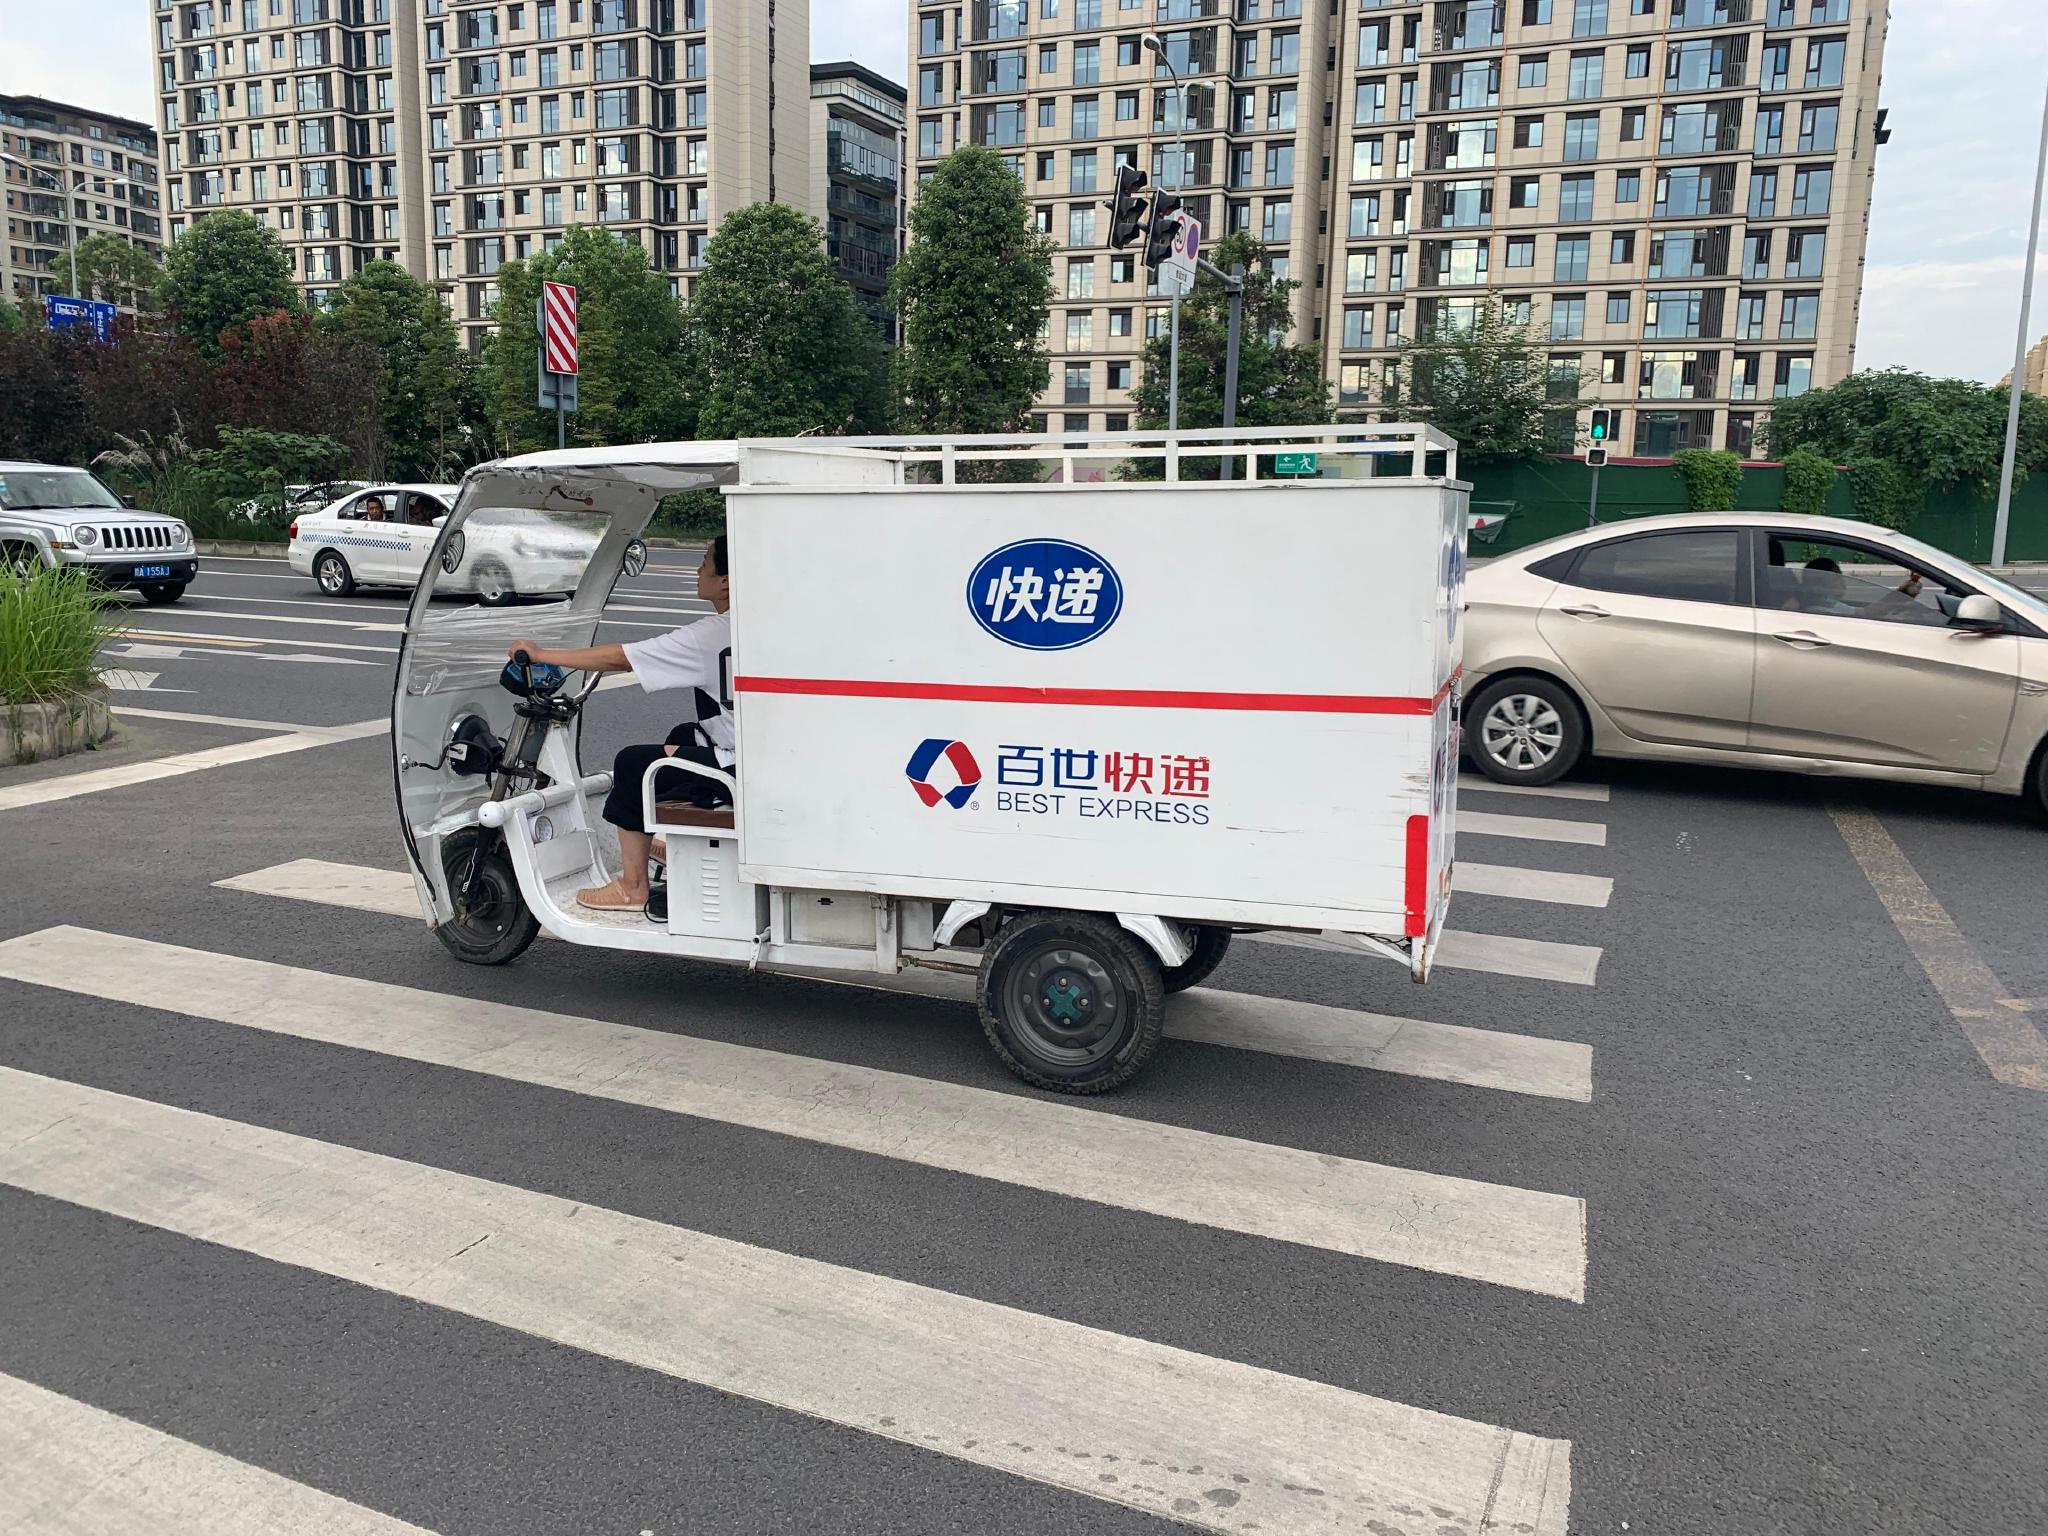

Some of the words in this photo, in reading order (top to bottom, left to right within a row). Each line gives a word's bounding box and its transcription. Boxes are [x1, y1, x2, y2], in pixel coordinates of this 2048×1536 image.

[985, 566, 1104, 624] 快递
[998, 744, 1210, 798] 百世快递
[997, 791, 1066, 815] BEST
[1079, 796, 1210, 825] EXPRESS
